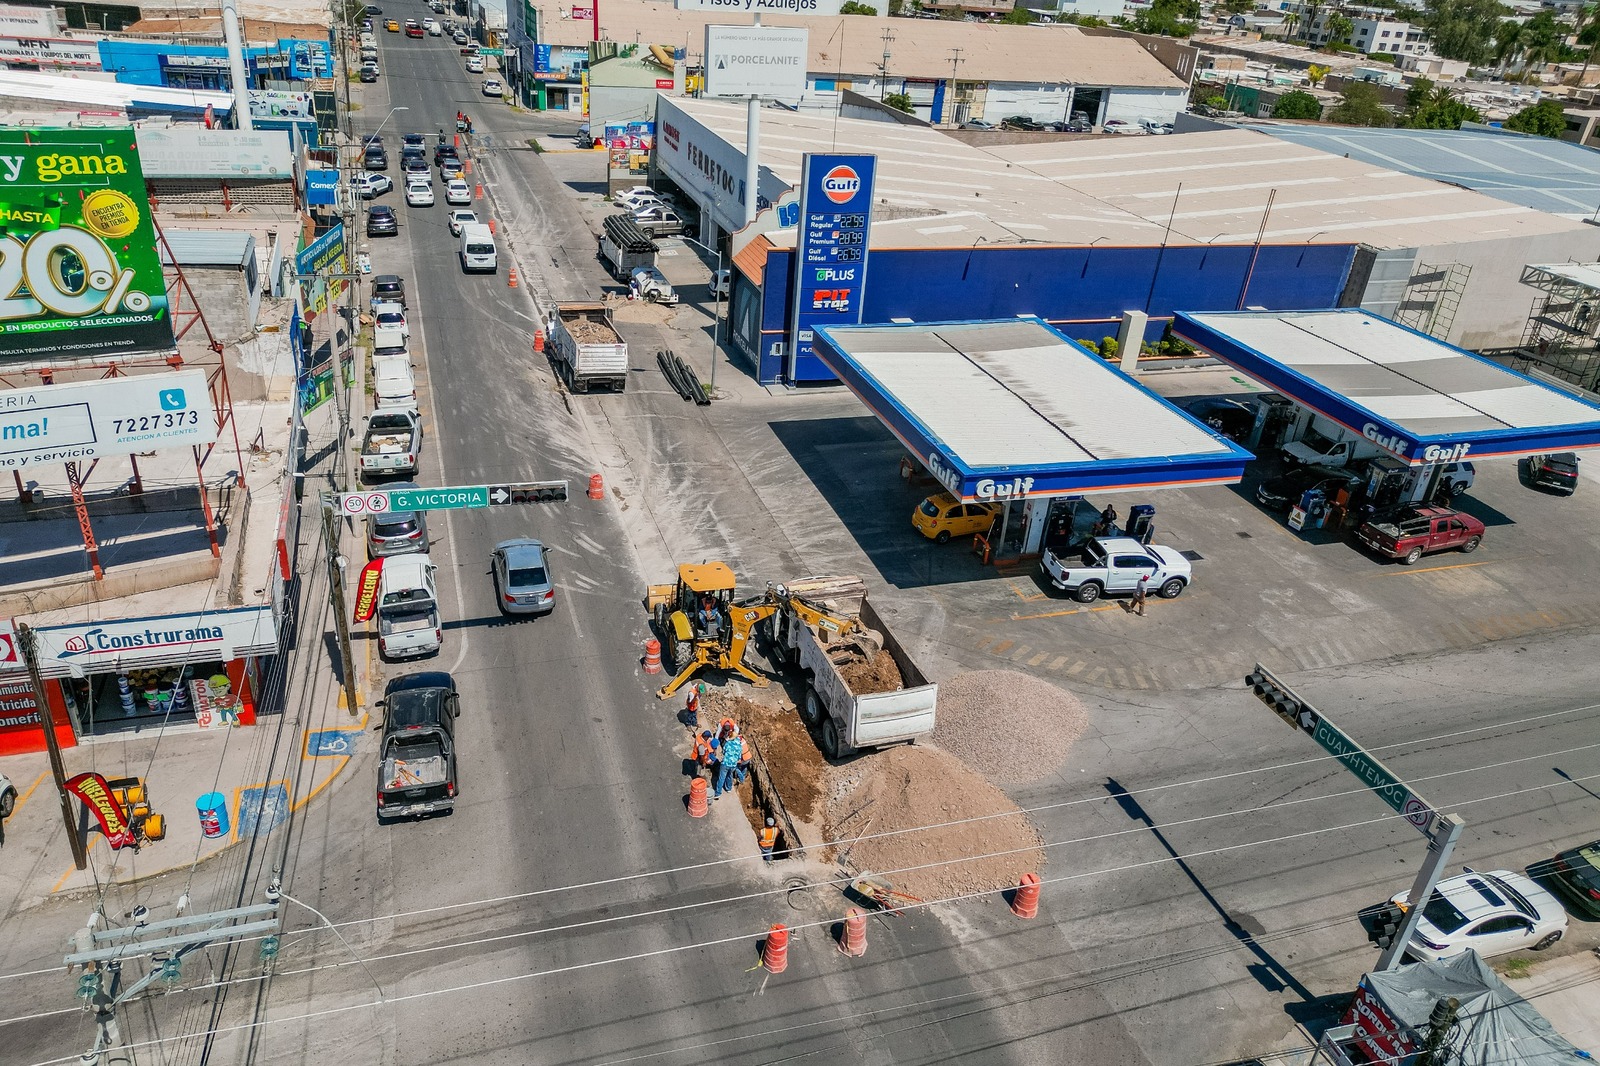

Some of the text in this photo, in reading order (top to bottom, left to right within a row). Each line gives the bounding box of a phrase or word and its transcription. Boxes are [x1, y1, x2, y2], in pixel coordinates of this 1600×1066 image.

[731, 55, 799, 65] PORCELANITE
[36, 153, 127, 182] gana
[310, 182, 335, 190] Comex
[826, 179, 858, 191] Gulf
[0, 210, 54, 224] HASTA
[92, 202, 125, 217] ENCUENTRA
[99, 210, 125, 224] PREMIOS
[101, 216, 131, 230] EN TIENDA
[809, 233, 835, 244] Premium
[814, 289, 851, 301] PIT
[813, 300, 849, 309] STOP
[6, 323, 20, 332] EN
[21, 319, 79, 331] PRODUCTOS
[80, 315, 154, 327] SELECCIONADOS
[62, 341, 106, 351] CONDICIONES
[114, 338, 135, 346] TIENDA
[113, 410, 198, 434] 7227373
[117, 433, 154, 444] ATENCION
[163, 427, 198, 438] CLIENTES
[1362, 422, 1409, 455] Gulf
[20, 456, 29, 466] y
[34, 447, 94, 462] servicio
[1424, 443, 1471, 462] Gulf
[928, 452, 961, 491] Gulf
[976, 477, 1034, 499] Gulf
[348, 499, 362, 508] 50
[397, 492, 482, 507] G. VICTORIA
[97, 625, 223, 650] Construrama
[1320, 727, 1403, 803] CUAUHTEMOC
